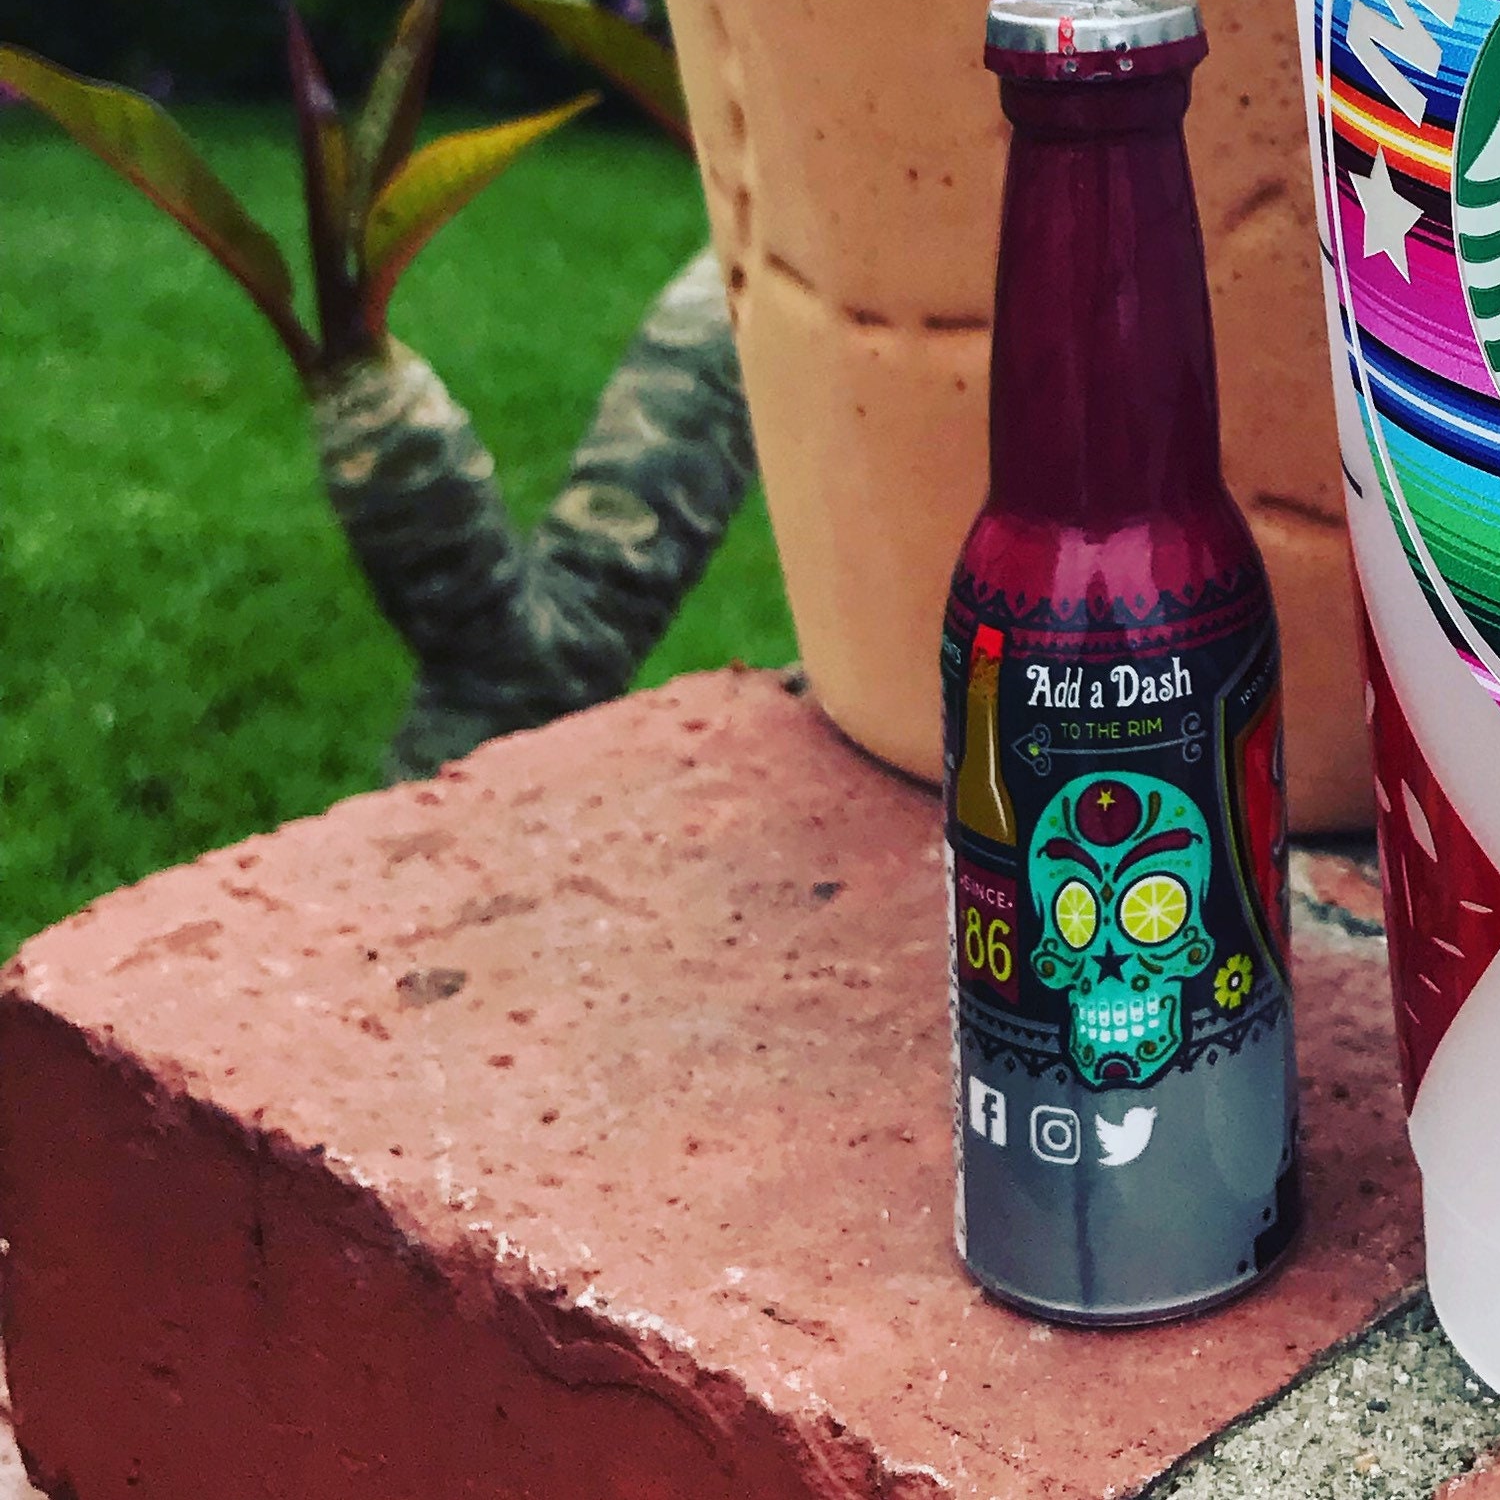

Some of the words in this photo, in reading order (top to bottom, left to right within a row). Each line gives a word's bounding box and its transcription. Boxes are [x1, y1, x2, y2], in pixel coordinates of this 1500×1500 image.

[1026, 664, 1083, 708] Add
[1090, 681, 1104, 709] a
[1110, 656, 1192, 707] Dash
[1061, 722, 1081, 740] TO
[1085, 722, 1120, 739] THE
[1127, 717, 1162, 737] RIM
